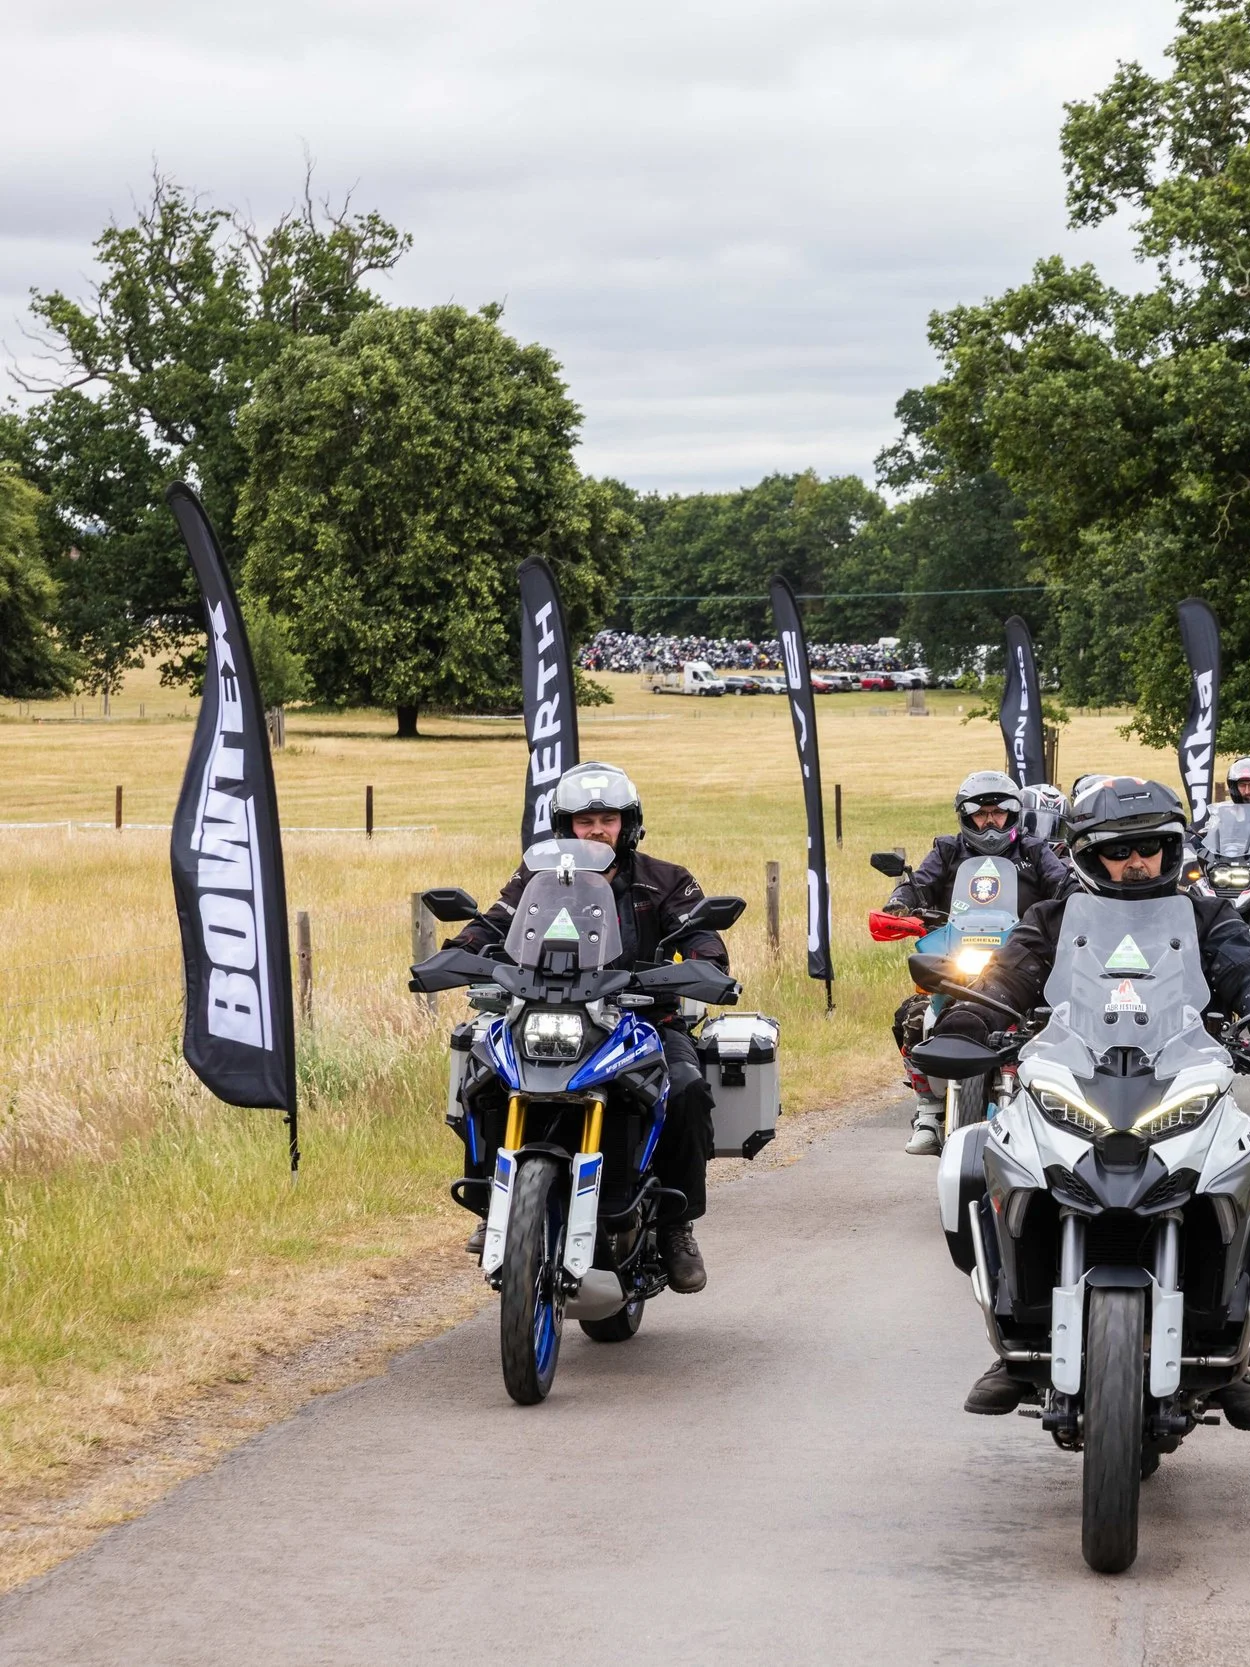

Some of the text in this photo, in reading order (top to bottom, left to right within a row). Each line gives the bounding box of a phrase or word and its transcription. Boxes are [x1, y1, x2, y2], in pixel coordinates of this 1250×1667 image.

[533, 601, 562, 836] BERTH
[1184, 669, 1213, 823] ukka
[194, 598, 268, 1050] BOWTEX
[1106, 1003, 1145, 1012] ABR FESTIVAL
